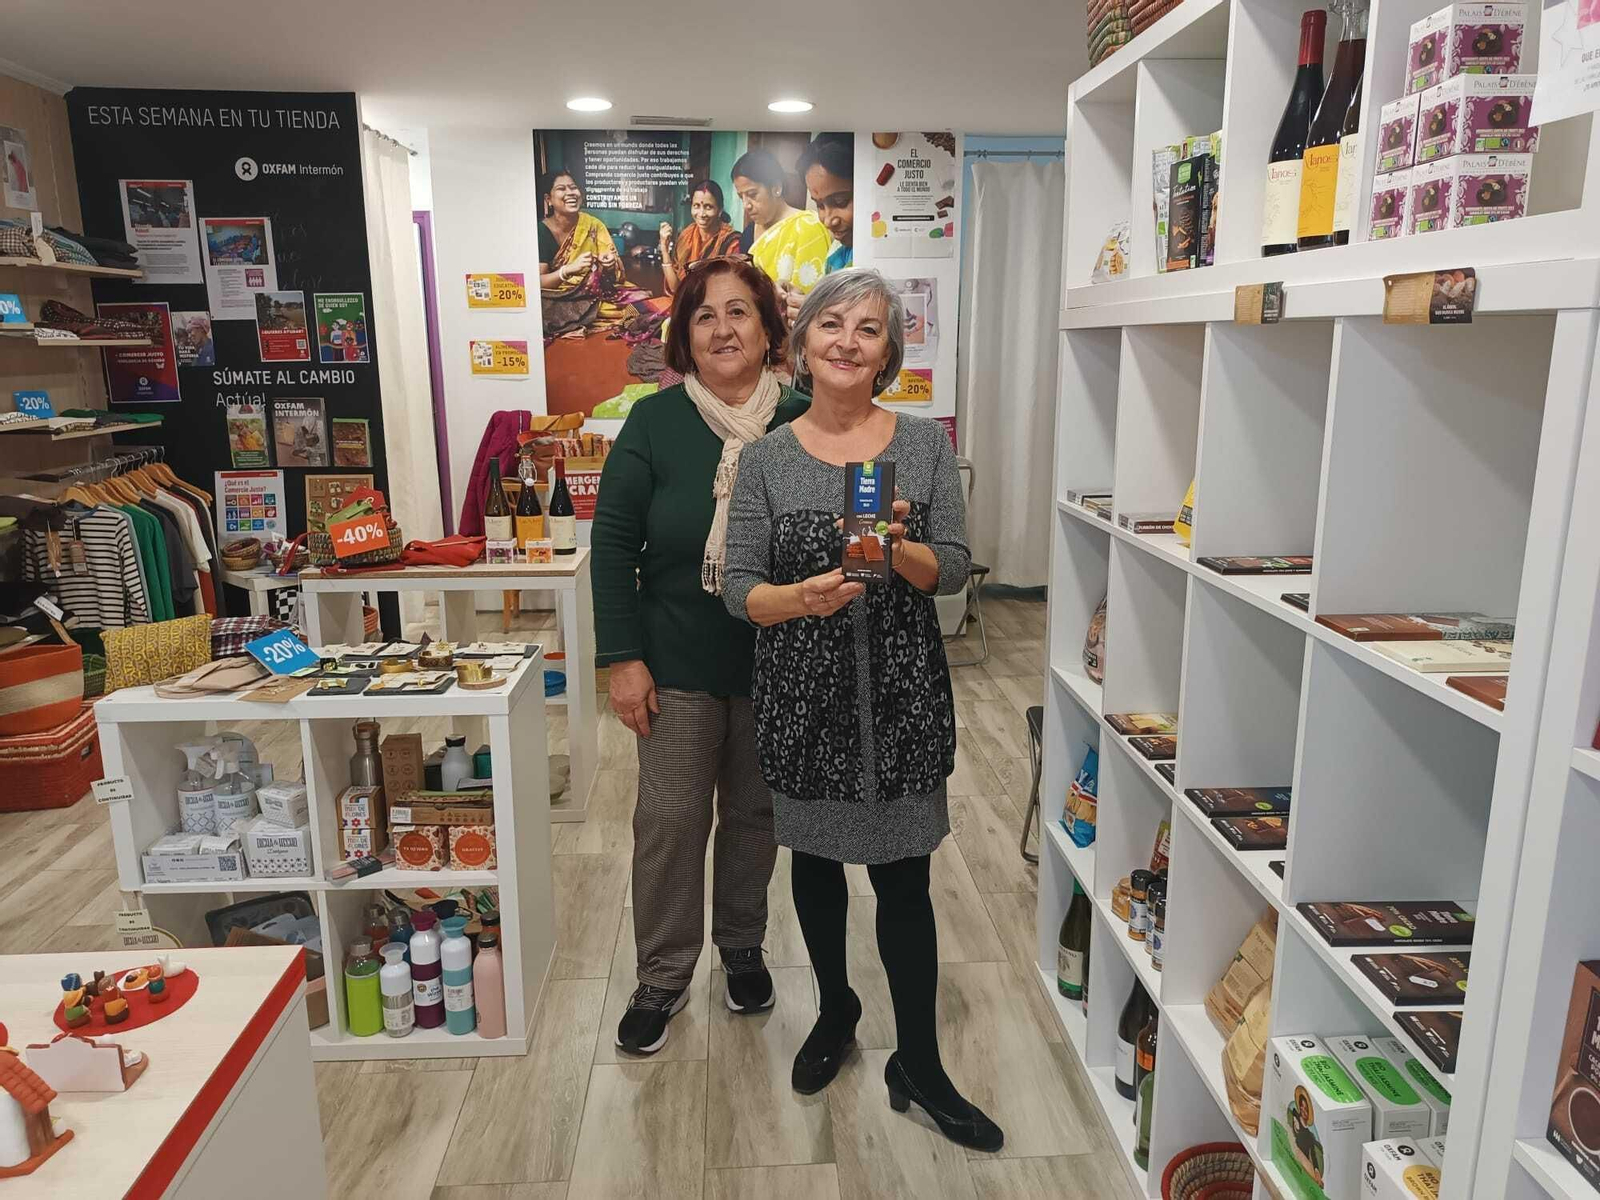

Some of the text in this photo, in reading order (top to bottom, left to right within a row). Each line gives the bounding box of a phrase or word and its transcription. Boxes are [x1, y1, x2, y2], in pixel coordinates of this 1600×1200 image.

[1582, 48, 1600, 62] QUE E
[88, 106, 340, 130] ESTA SEMANA EN TU TIENDA
[910, 149, 918, 158] EL
[262, 164, 344, 175] OXFAM Intermón
[898, 159, 931, 169] COMERCIO
[905, 170, 924, 179] JUSTO
[494, 290, 522, 300] -20%
[497, 357, 525, 367] -15%
[212, 367, 355, 385] SÚMATE AL CAMBIO
[903, 385, 929, 394] -20%
[19, 395, 50, 411] -20%
[216, 392, 266, 408] Actúa!
[275, 408, 320, 417] INTERMÓN
[567, 485, 598, 495] CRA
[337, 522, 383, 544] -40%
[264, 635, 306, 665] -20%
[1384, 1144, 1402, 1160] OXFAM
[1417, 1174, 1434, 1189] THAI
[1426, 1172, 1439, 1184] BIO
